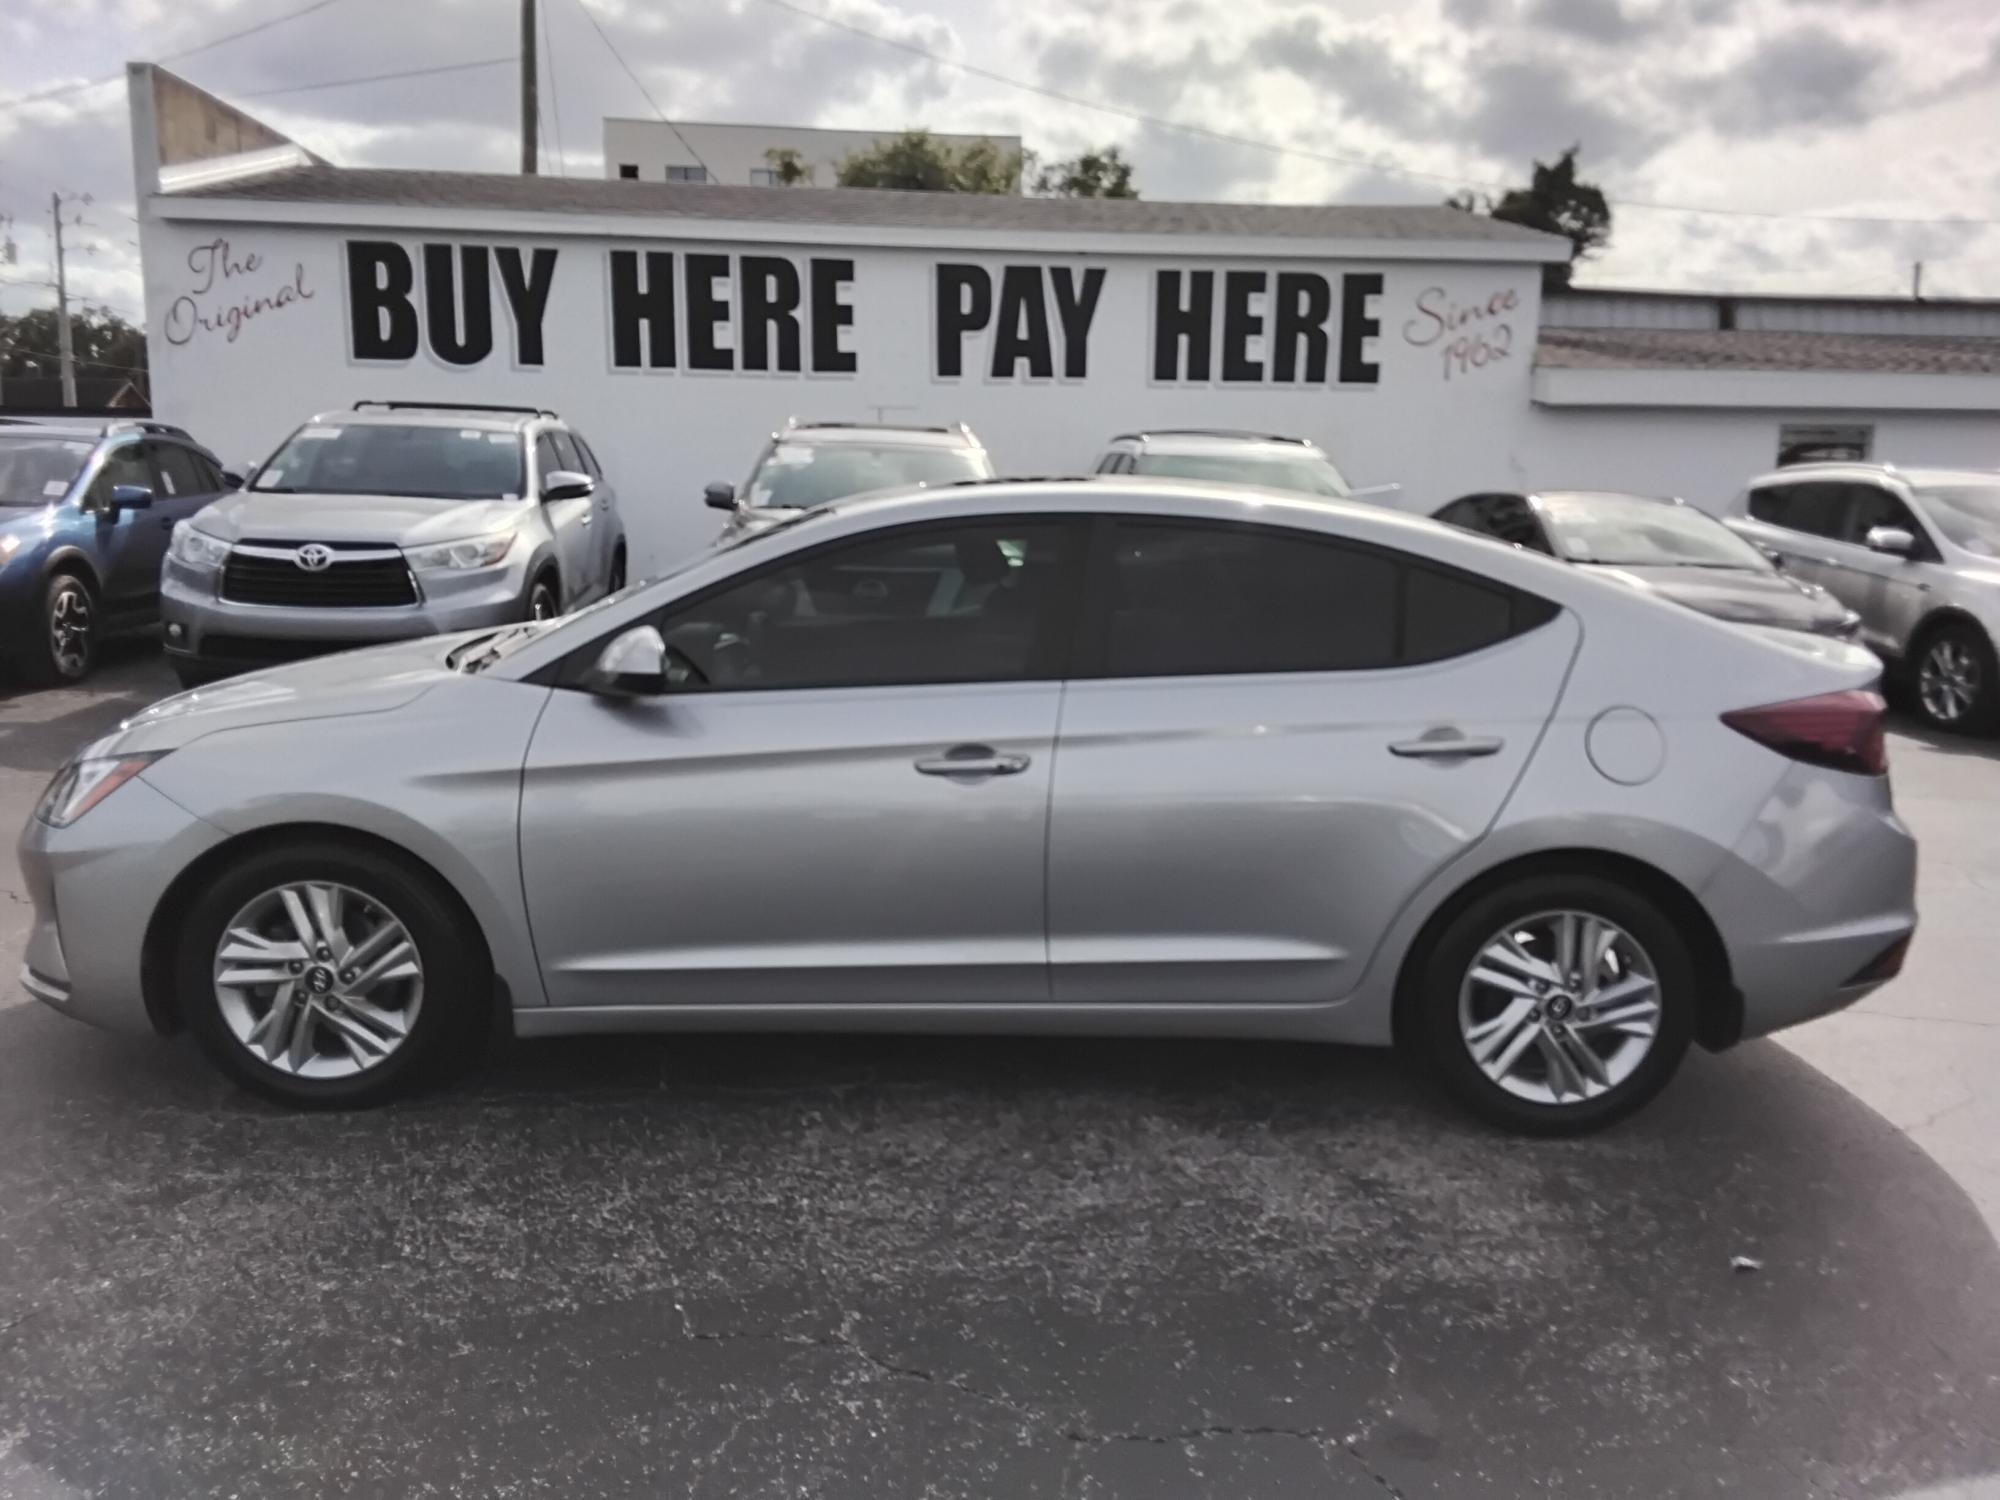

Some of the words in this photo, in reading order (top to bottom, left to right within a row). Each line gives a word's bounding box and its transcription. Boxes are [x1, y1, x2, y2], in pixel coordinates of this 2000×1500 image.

[188, 237, 263, 294] The
[164, 264, 315, 345] Original
[346, 240, 559, 366] BUY
[611, 250, 857, 373] HERE
[935, 263, 1107, 379] PAY
[1153, 269, 1384, 384] HERE
[1402, 286, 1520, 346] Since
[1442, 324, 1512, 381] 1962
